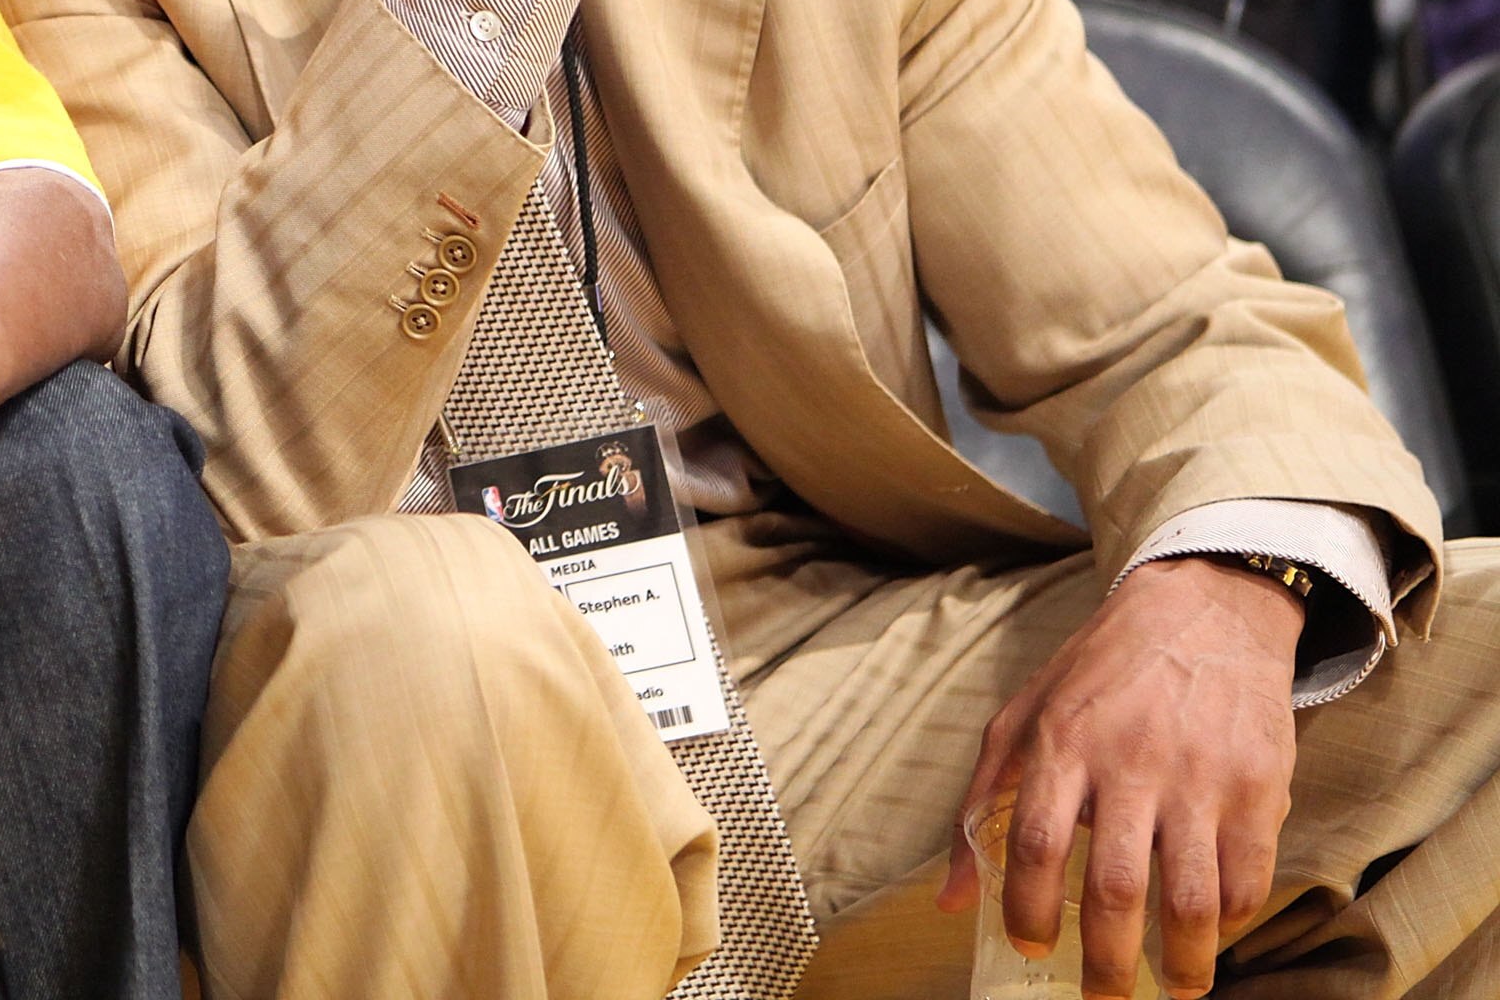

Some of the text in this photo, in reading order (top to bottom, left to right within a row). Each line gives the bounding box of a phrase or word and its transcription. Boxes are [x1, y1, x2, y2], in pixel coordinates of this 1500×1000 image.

[503, 465, 642, 521] The Finals
[529, 521, 620, 556] ALL GAMES
[550, 559, 597, 578] MEDIA
[578, 589, 660, 615] Stephen A.
[608, 642, 635, 657] ith
[636, 687, 664, 701] adio
